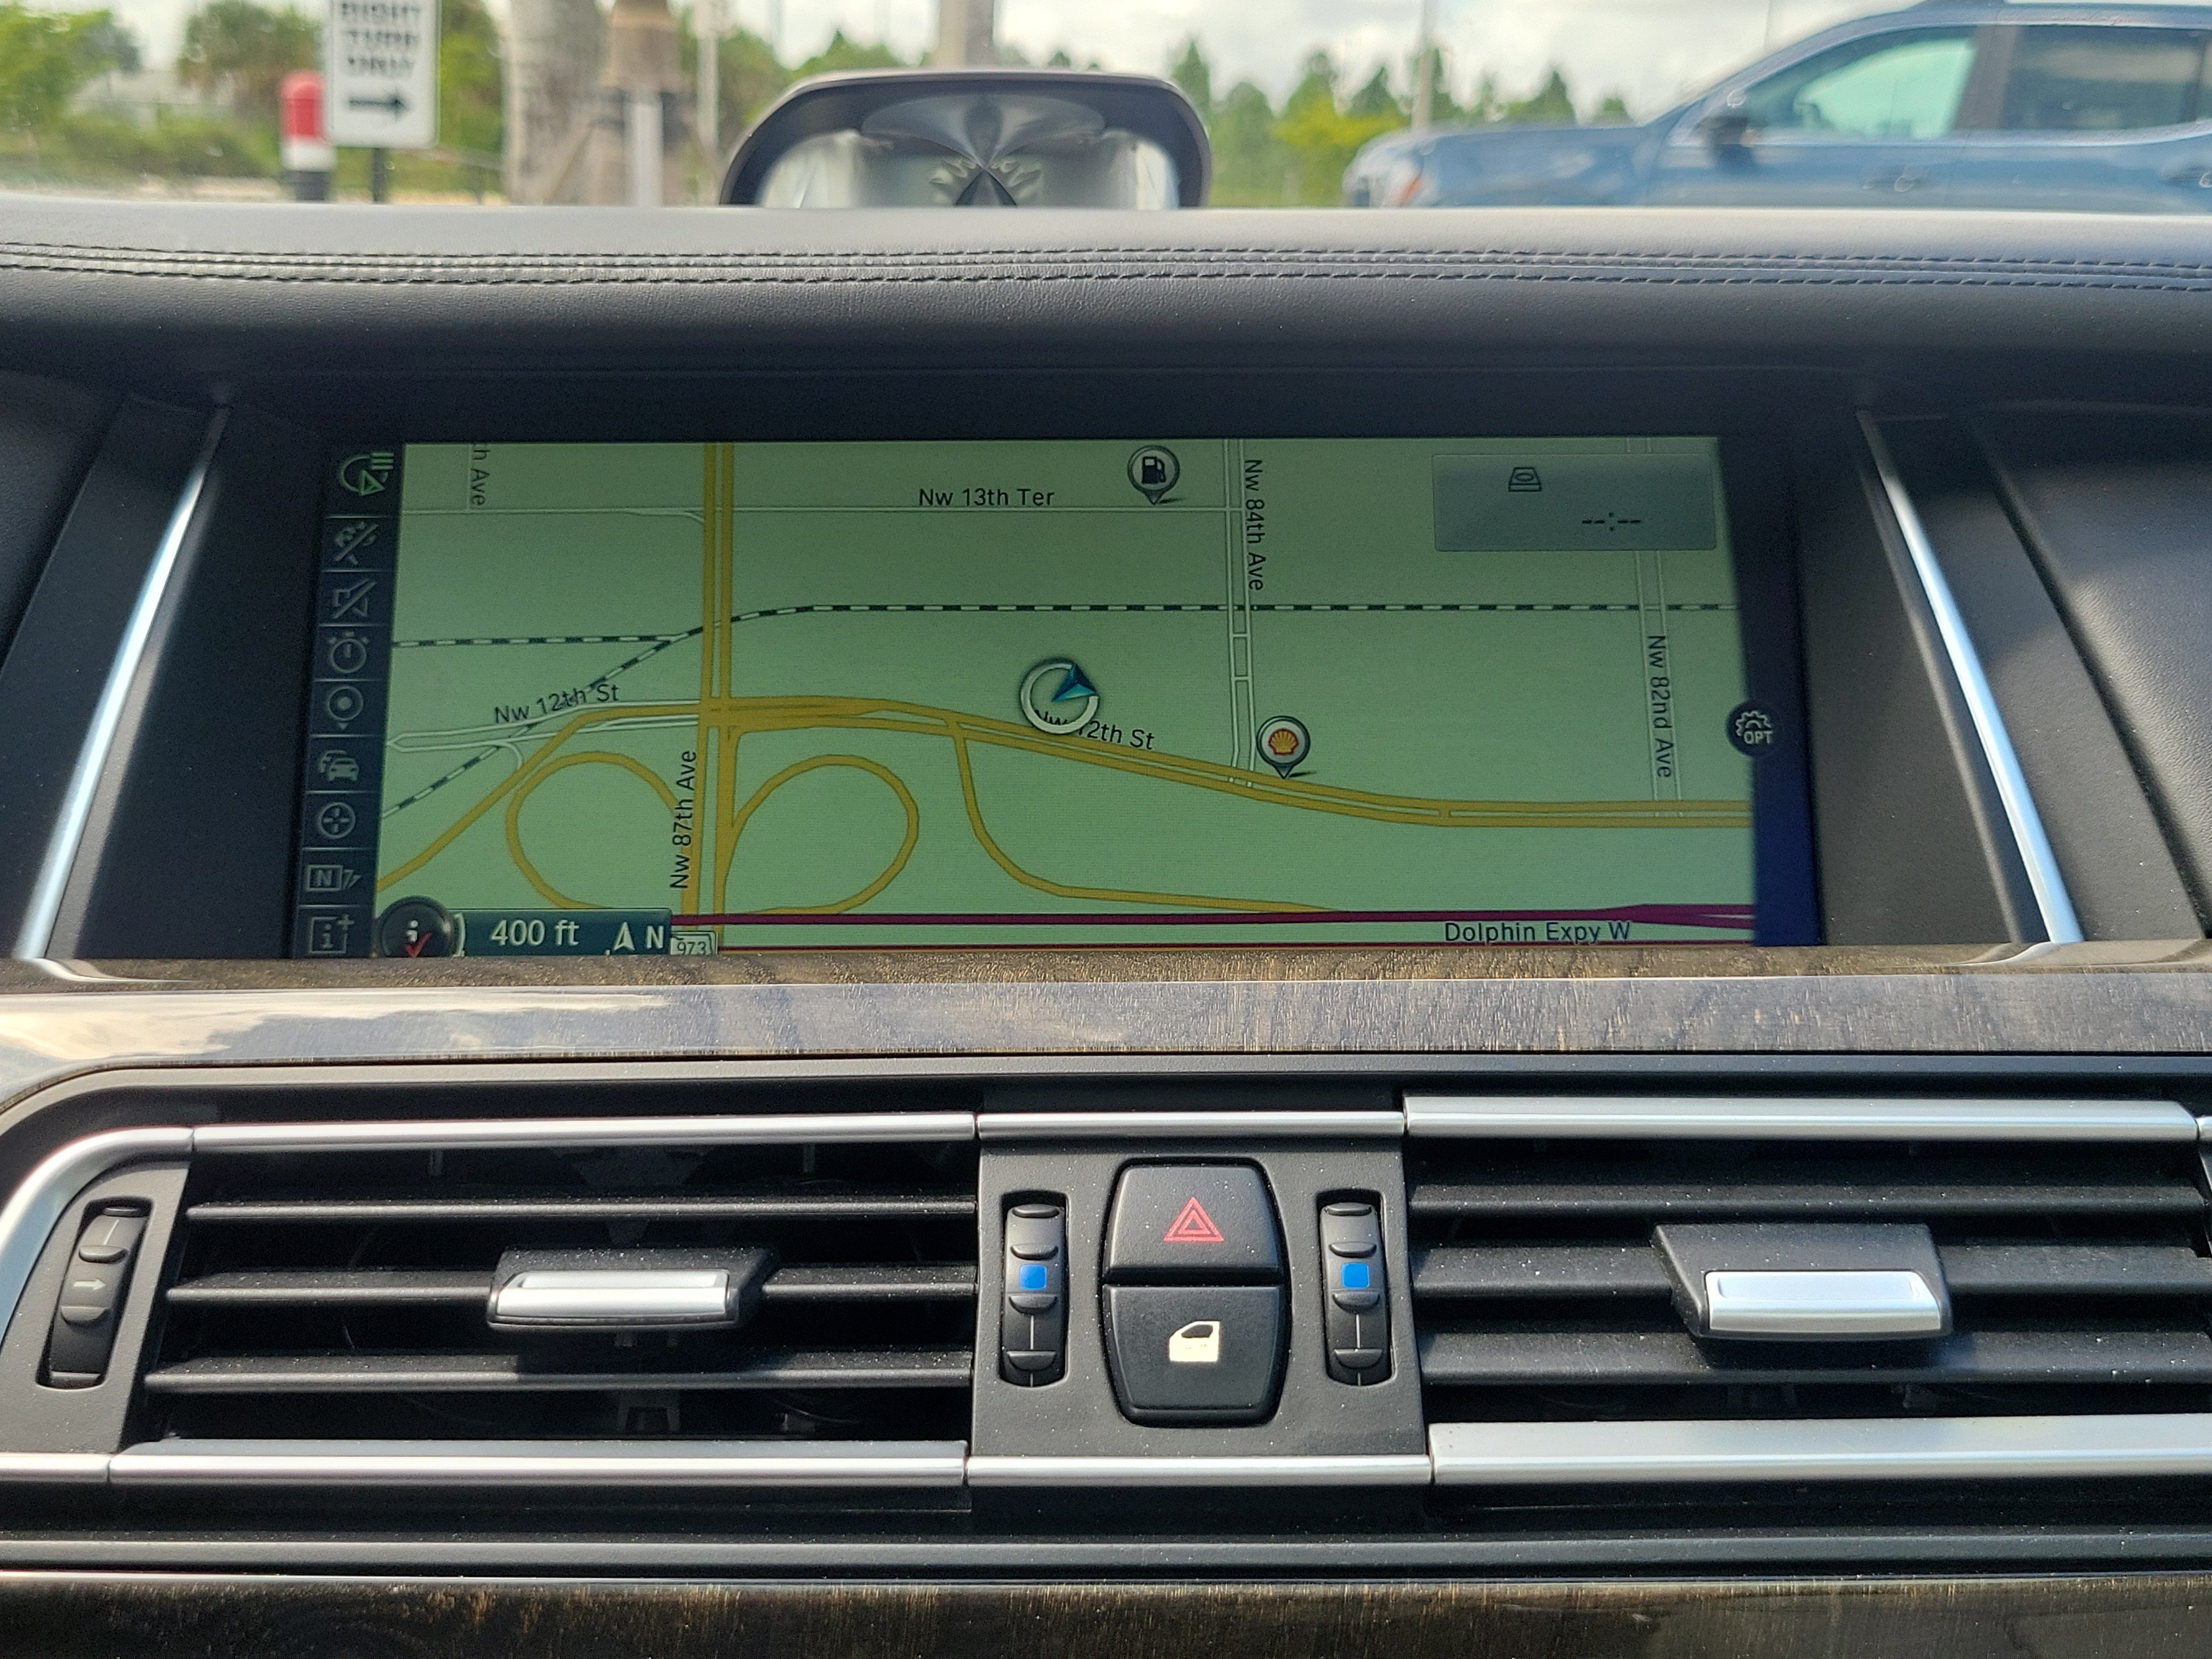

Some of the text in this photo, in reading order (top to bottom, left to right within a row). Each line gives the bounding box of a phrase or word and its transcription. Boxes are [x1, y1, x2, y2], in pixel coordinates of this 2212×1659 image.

[470, 468, 490, 506] Ave
[919, 488, 1055, 506] Nw 13th Ter
[1245, 460, 1266, 591] Nw 84th Ave
[495, 684, 620, 724] Nw 12th St
[1647, 635, 1674, 777] Nw 82nd Ave
[1129, 729, 1154, 750] St
[1743, 730, 1773, 744] OPT
[670, 751, 696, 889] Nw 87th Ave
[490, 919, 665, 949] 400 ft N
[1444, 921, 1630, 944] Dolphin Expy W
[677, 941, 707, 955] 973
